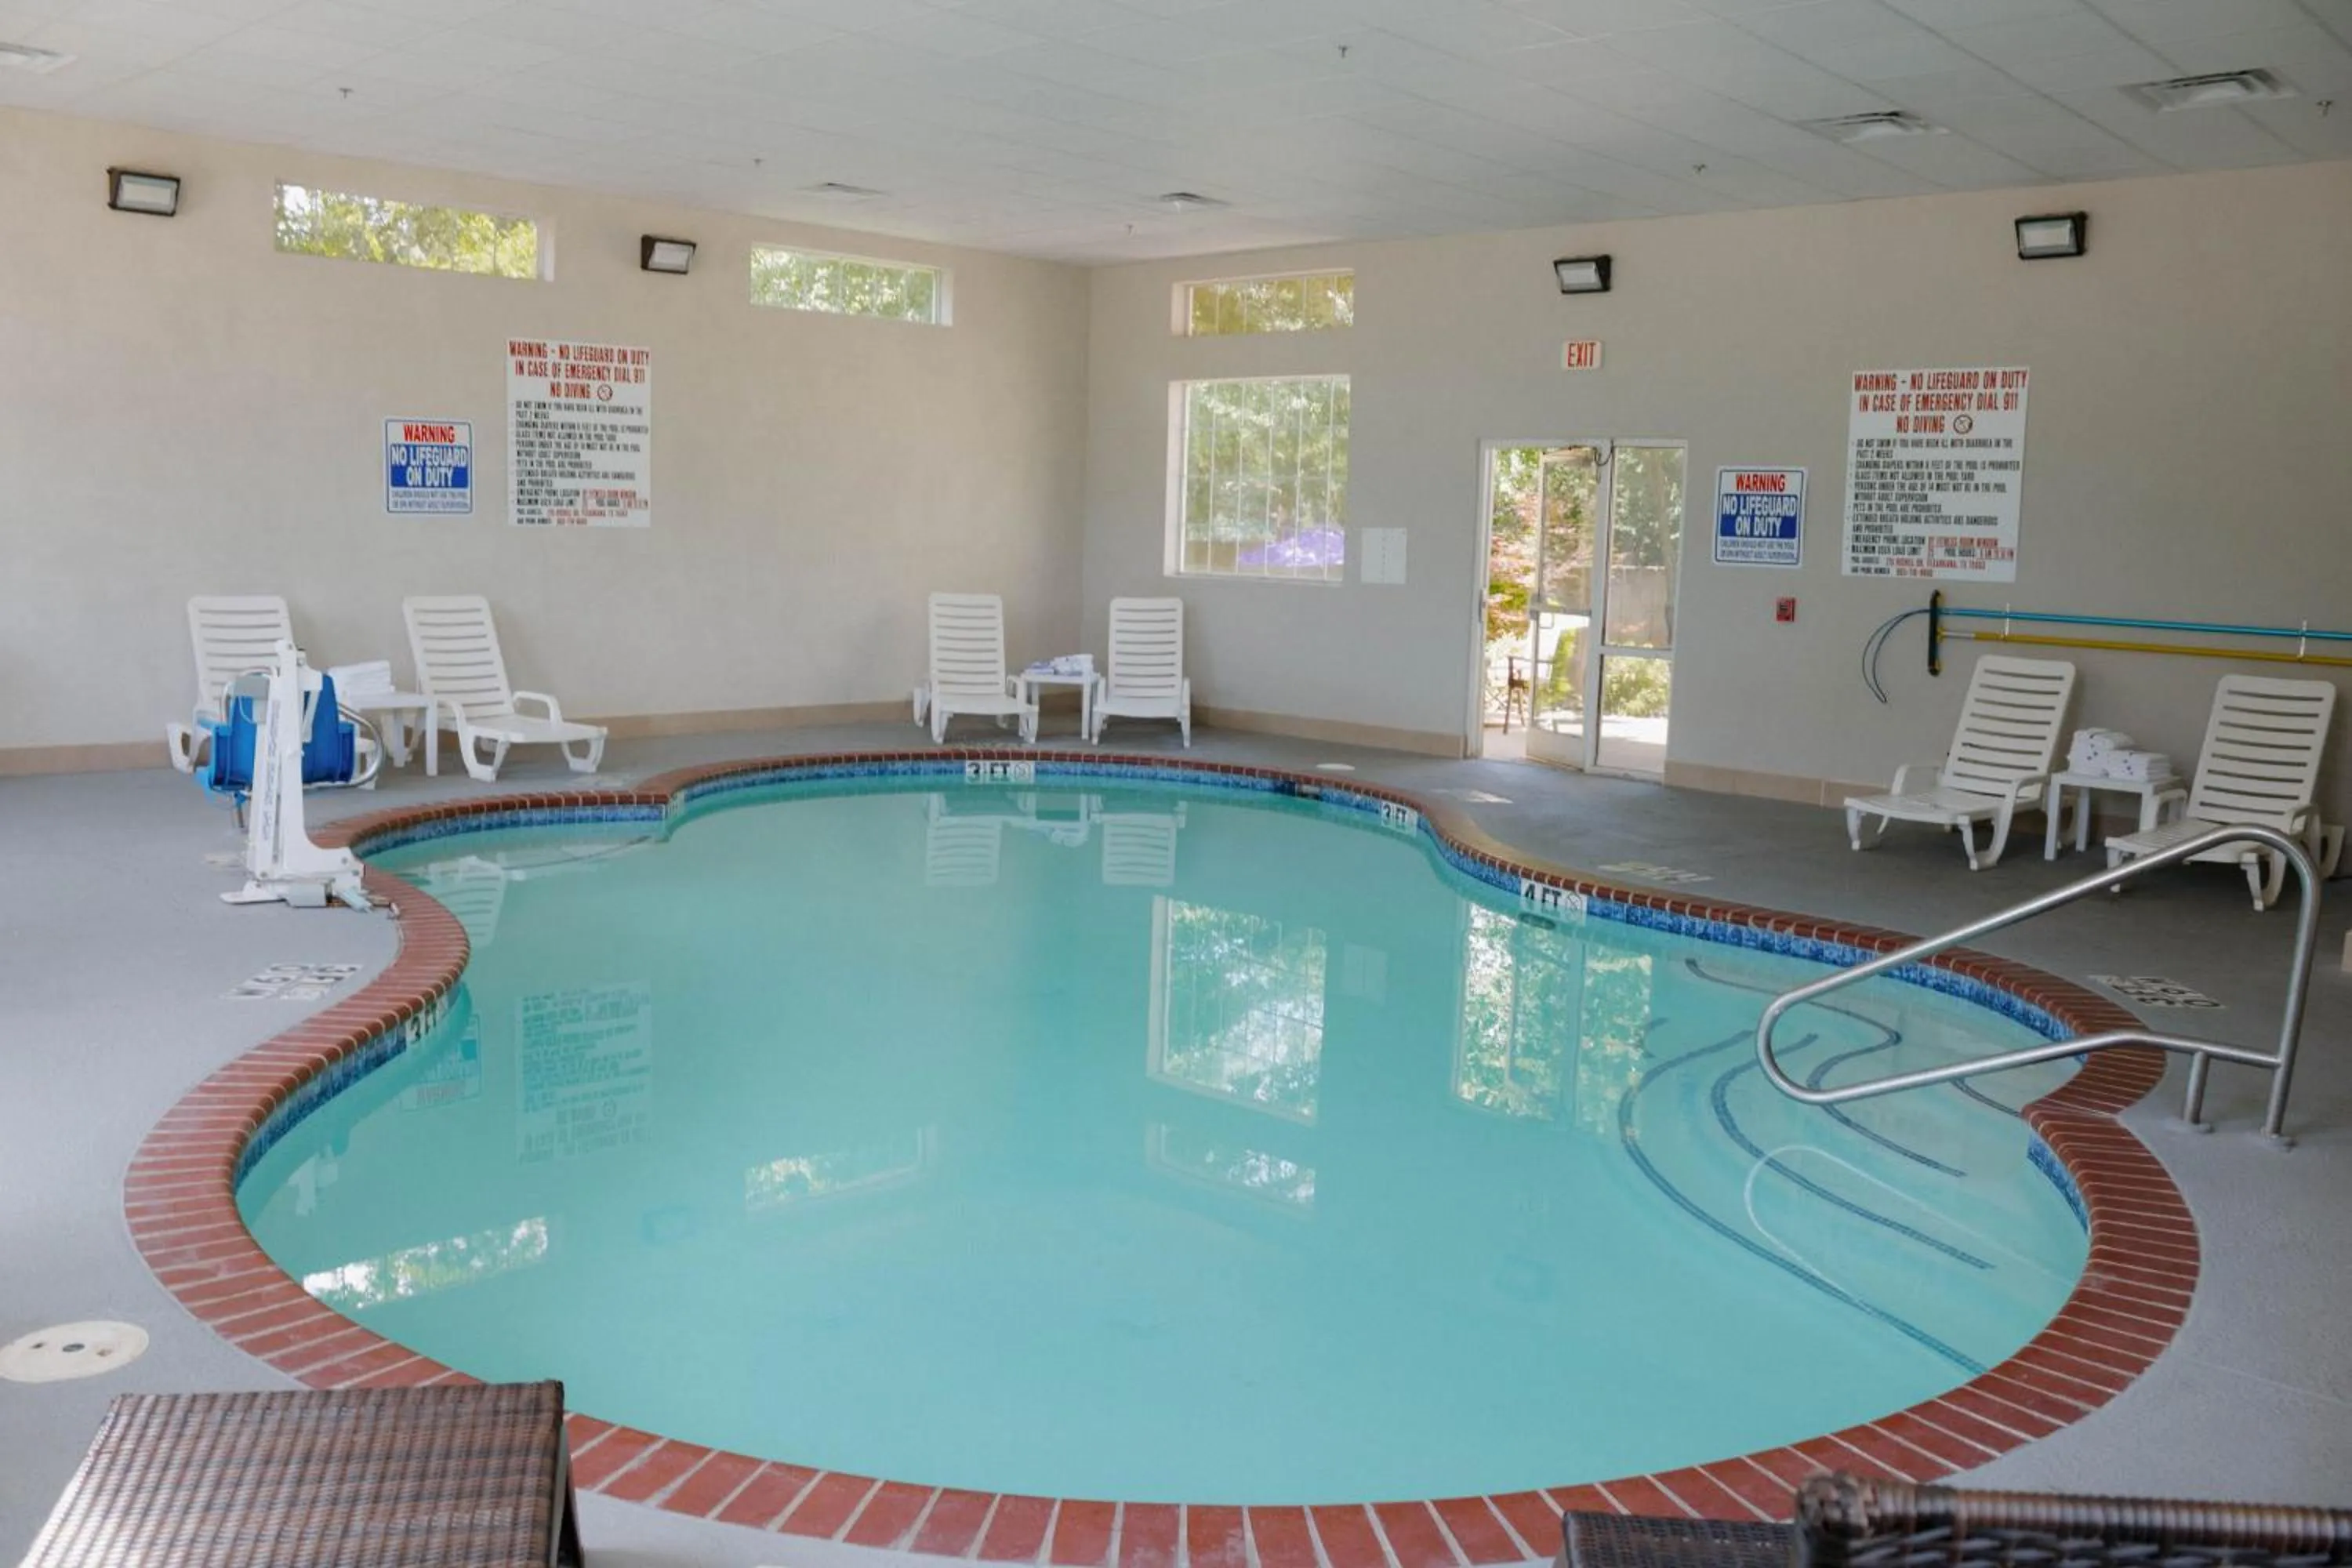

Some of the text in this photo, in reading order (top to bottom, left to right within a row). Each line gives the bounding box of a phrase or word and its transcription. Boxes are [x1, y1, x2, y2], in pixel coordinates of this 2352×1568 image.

[509, 339, 548, 359] WARNING
[559, 343, 569, 360] NO
[573, 344, 614, 364] LIFEGUARD
[617, 347, 628, 365] ON
[630, 349, 649, 366] DUTY
[1568, 342, 1596, 367] EXIT
[515, 360, 645, 383] IN CASE OF EMERGENCY DIAL 911
[1854, 372, 1896, 391] WARNING
[1910, 372, 1923, 390] NO
[1927, 371, 1979, 390] LIFEGUARD
[1984, 370, 1997, 390] ON
[2002, 369, 2027, 389] DUTY
[550, 381, 590, 399] NO DIVING
[1860, 391, 2018, 412] IN CASE OF EMERGENCY DIAL 911
[404, 424, 456, 443] WARNING
[1896, 415, 1945, 434] NO DIVING
[392, 445, 467, 468] NO LIFEGUARD
[406, 466, 452, 487] ON DUTY
[1737, 474, 1785, 492] WARNING
[1723, 495, 1796, 517] NO LIFEGUARD
[1736, 516, 1782, 537] ON DUTY
[1525, 884, 1562, 908] 4 FT
